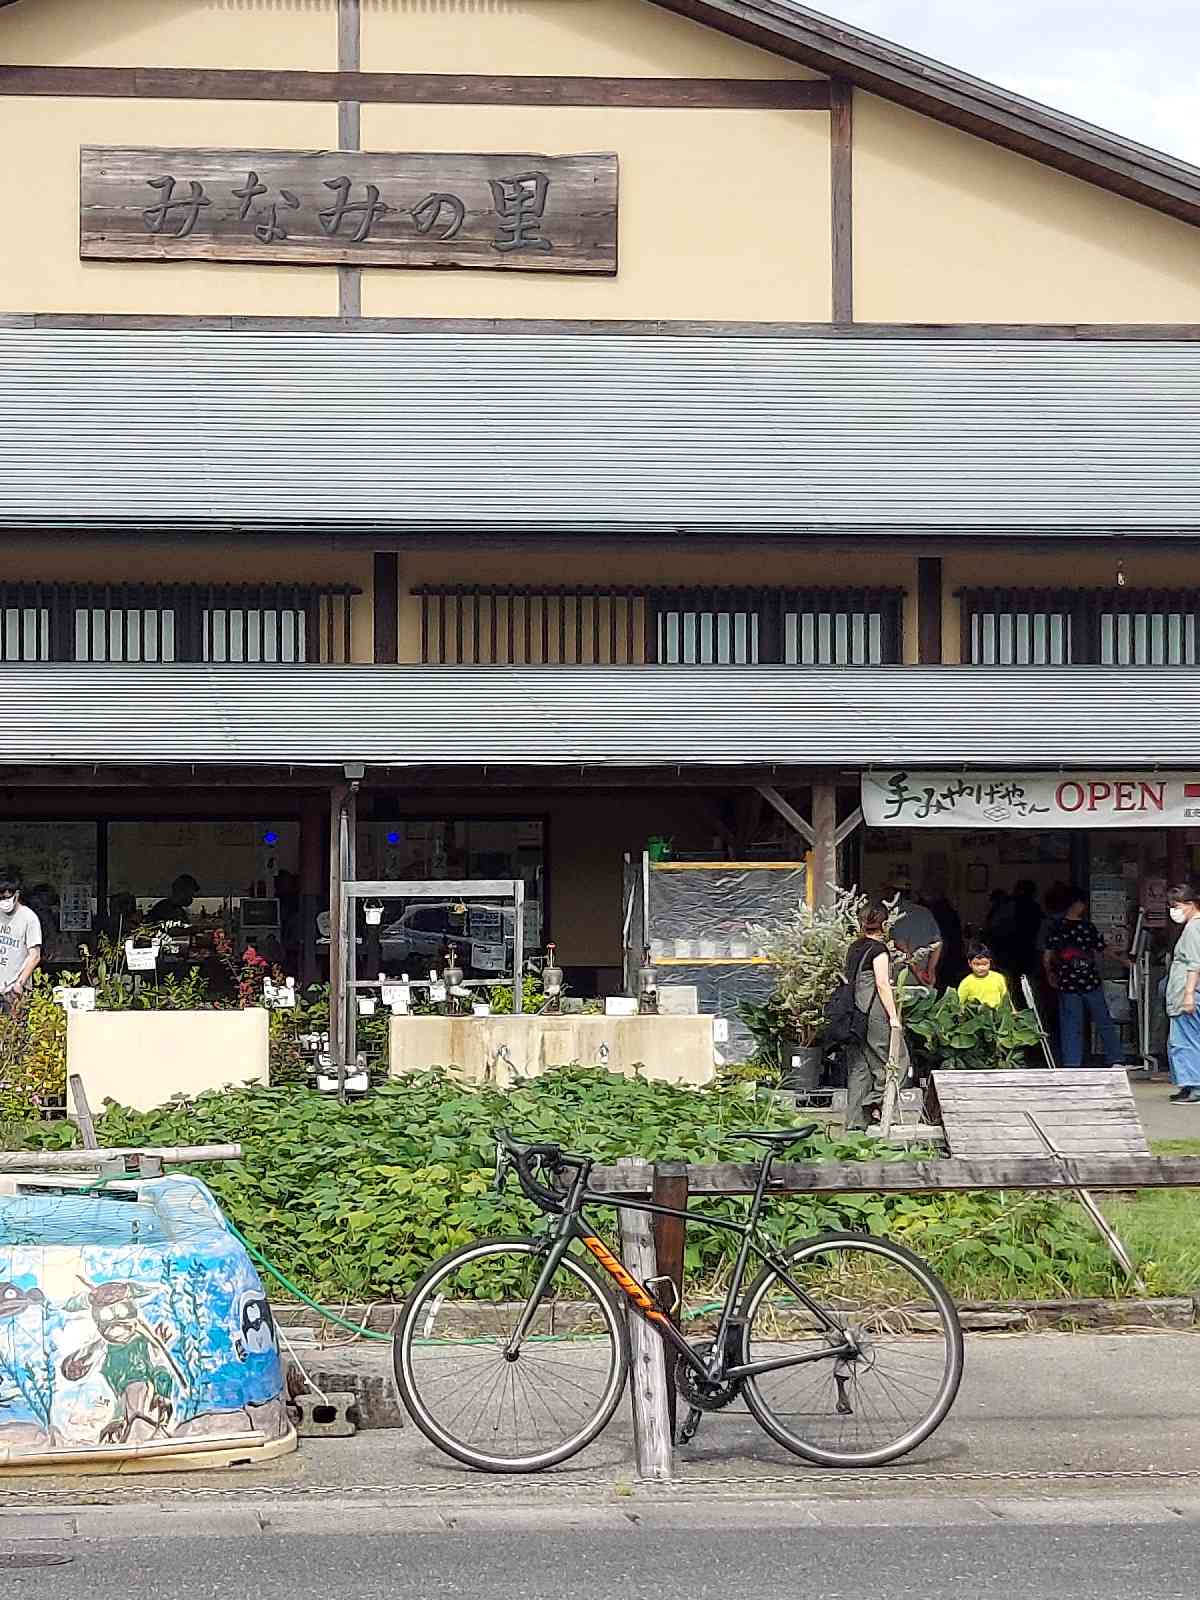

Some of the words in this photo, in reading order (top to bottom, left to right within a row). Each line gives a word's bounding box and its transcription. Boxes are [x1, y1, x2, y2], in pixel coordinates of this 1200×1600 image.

[142, 171, 553, 252] みなみの里
[1055, 781, 1167, 811] OPEN
